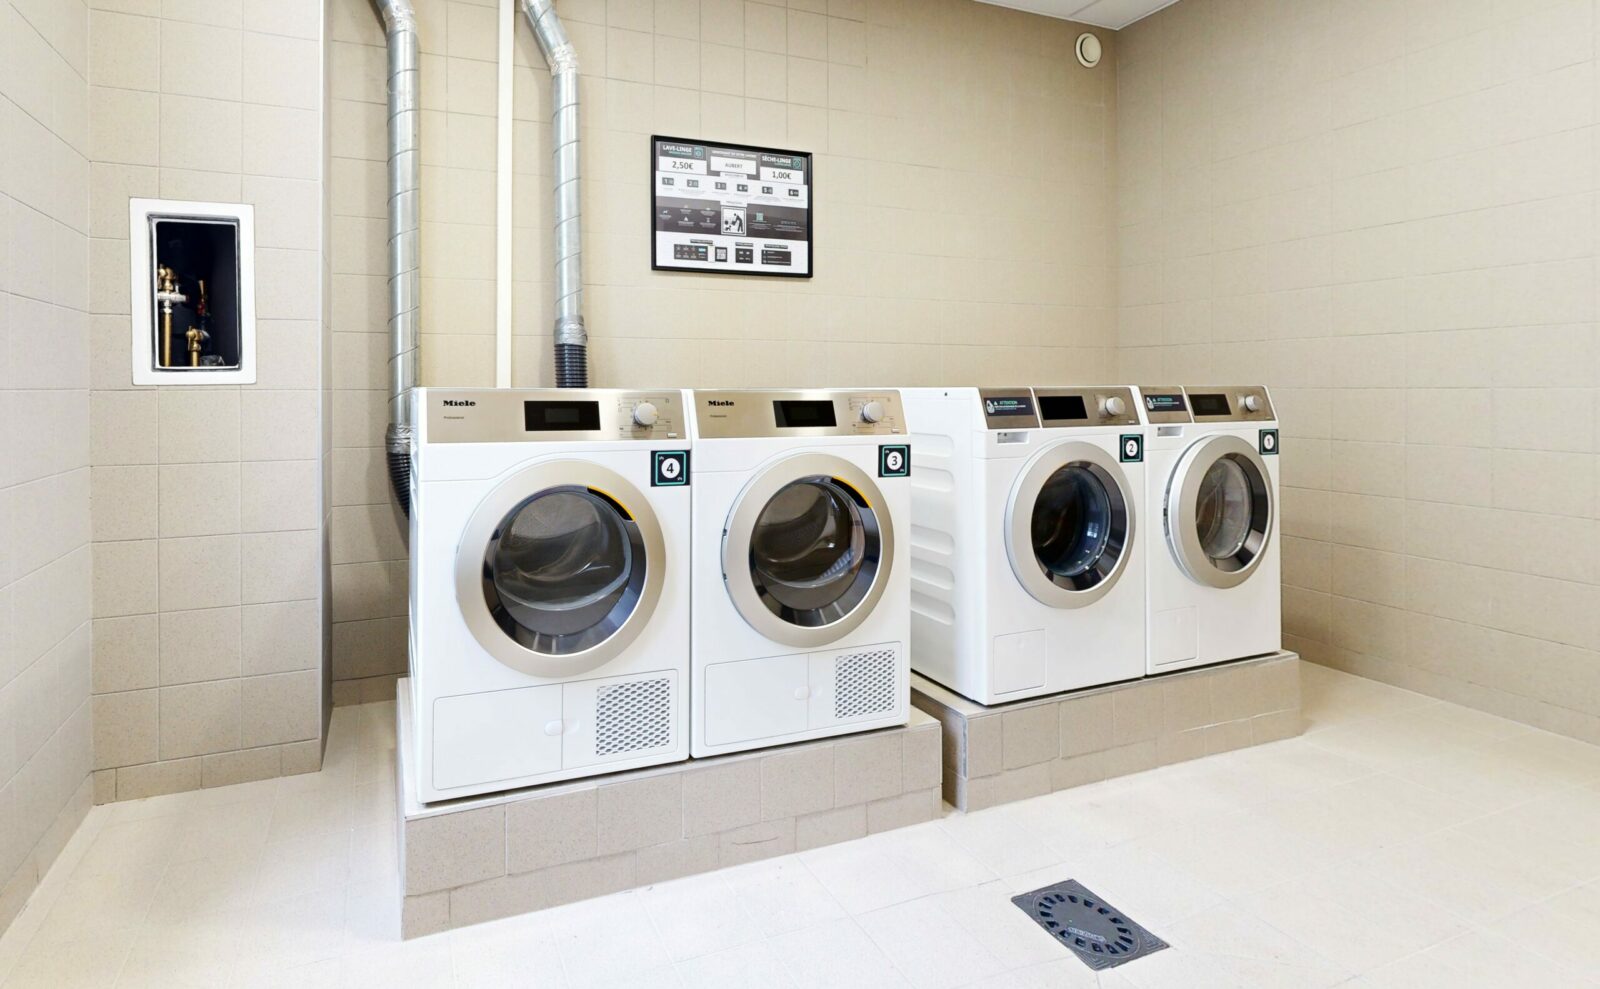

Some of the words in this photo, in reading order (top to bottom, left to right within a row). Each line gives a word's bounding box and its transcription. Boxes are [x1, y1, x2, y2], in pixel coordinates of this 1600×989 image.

[662, 144, 693, 153] LAVE-LINGE
[672, 160, 694, 170] 2,50€
[772, 170, 792, 180] 1,00€
[1128, 443, 1134, 453] 2
[891, 455, 898, 466] 3
[666, 462, 674, 474] 4
